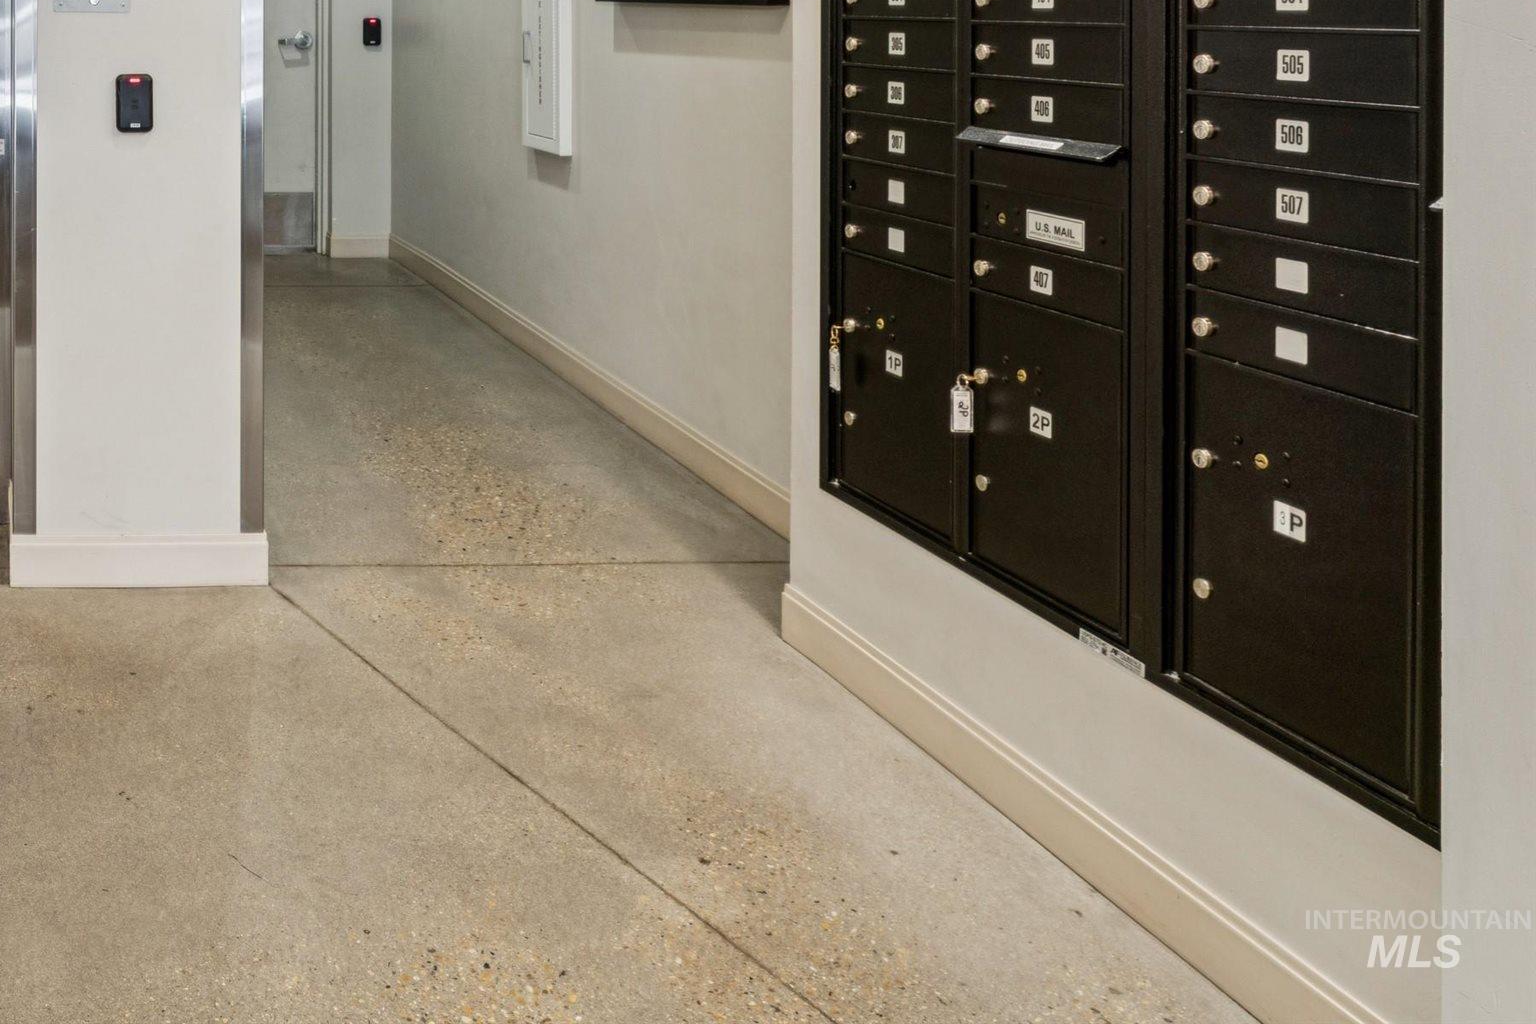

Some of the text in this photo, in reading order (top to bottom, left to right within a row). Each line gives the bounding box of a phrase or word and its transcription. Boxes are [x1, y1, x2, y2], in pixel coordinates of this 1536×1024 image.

[1034, 42, 1051, 60] 405
[1282, 55, 1304, 74] 505
[1033, 99, 1050, 118] 406
[891, 134, 903, 150] 307
[1281, 125, 1303, 145] 506
[1281, 194, 1303, 215] 507
[1035, 221, 1052, 234] U.S.
[1054, 225, 1075, 239] MAIL
[1033, 270, 1049, 289] 407
[887, 355, 901, 371] 1P
[1032, 413, 1050, 431] 2P
